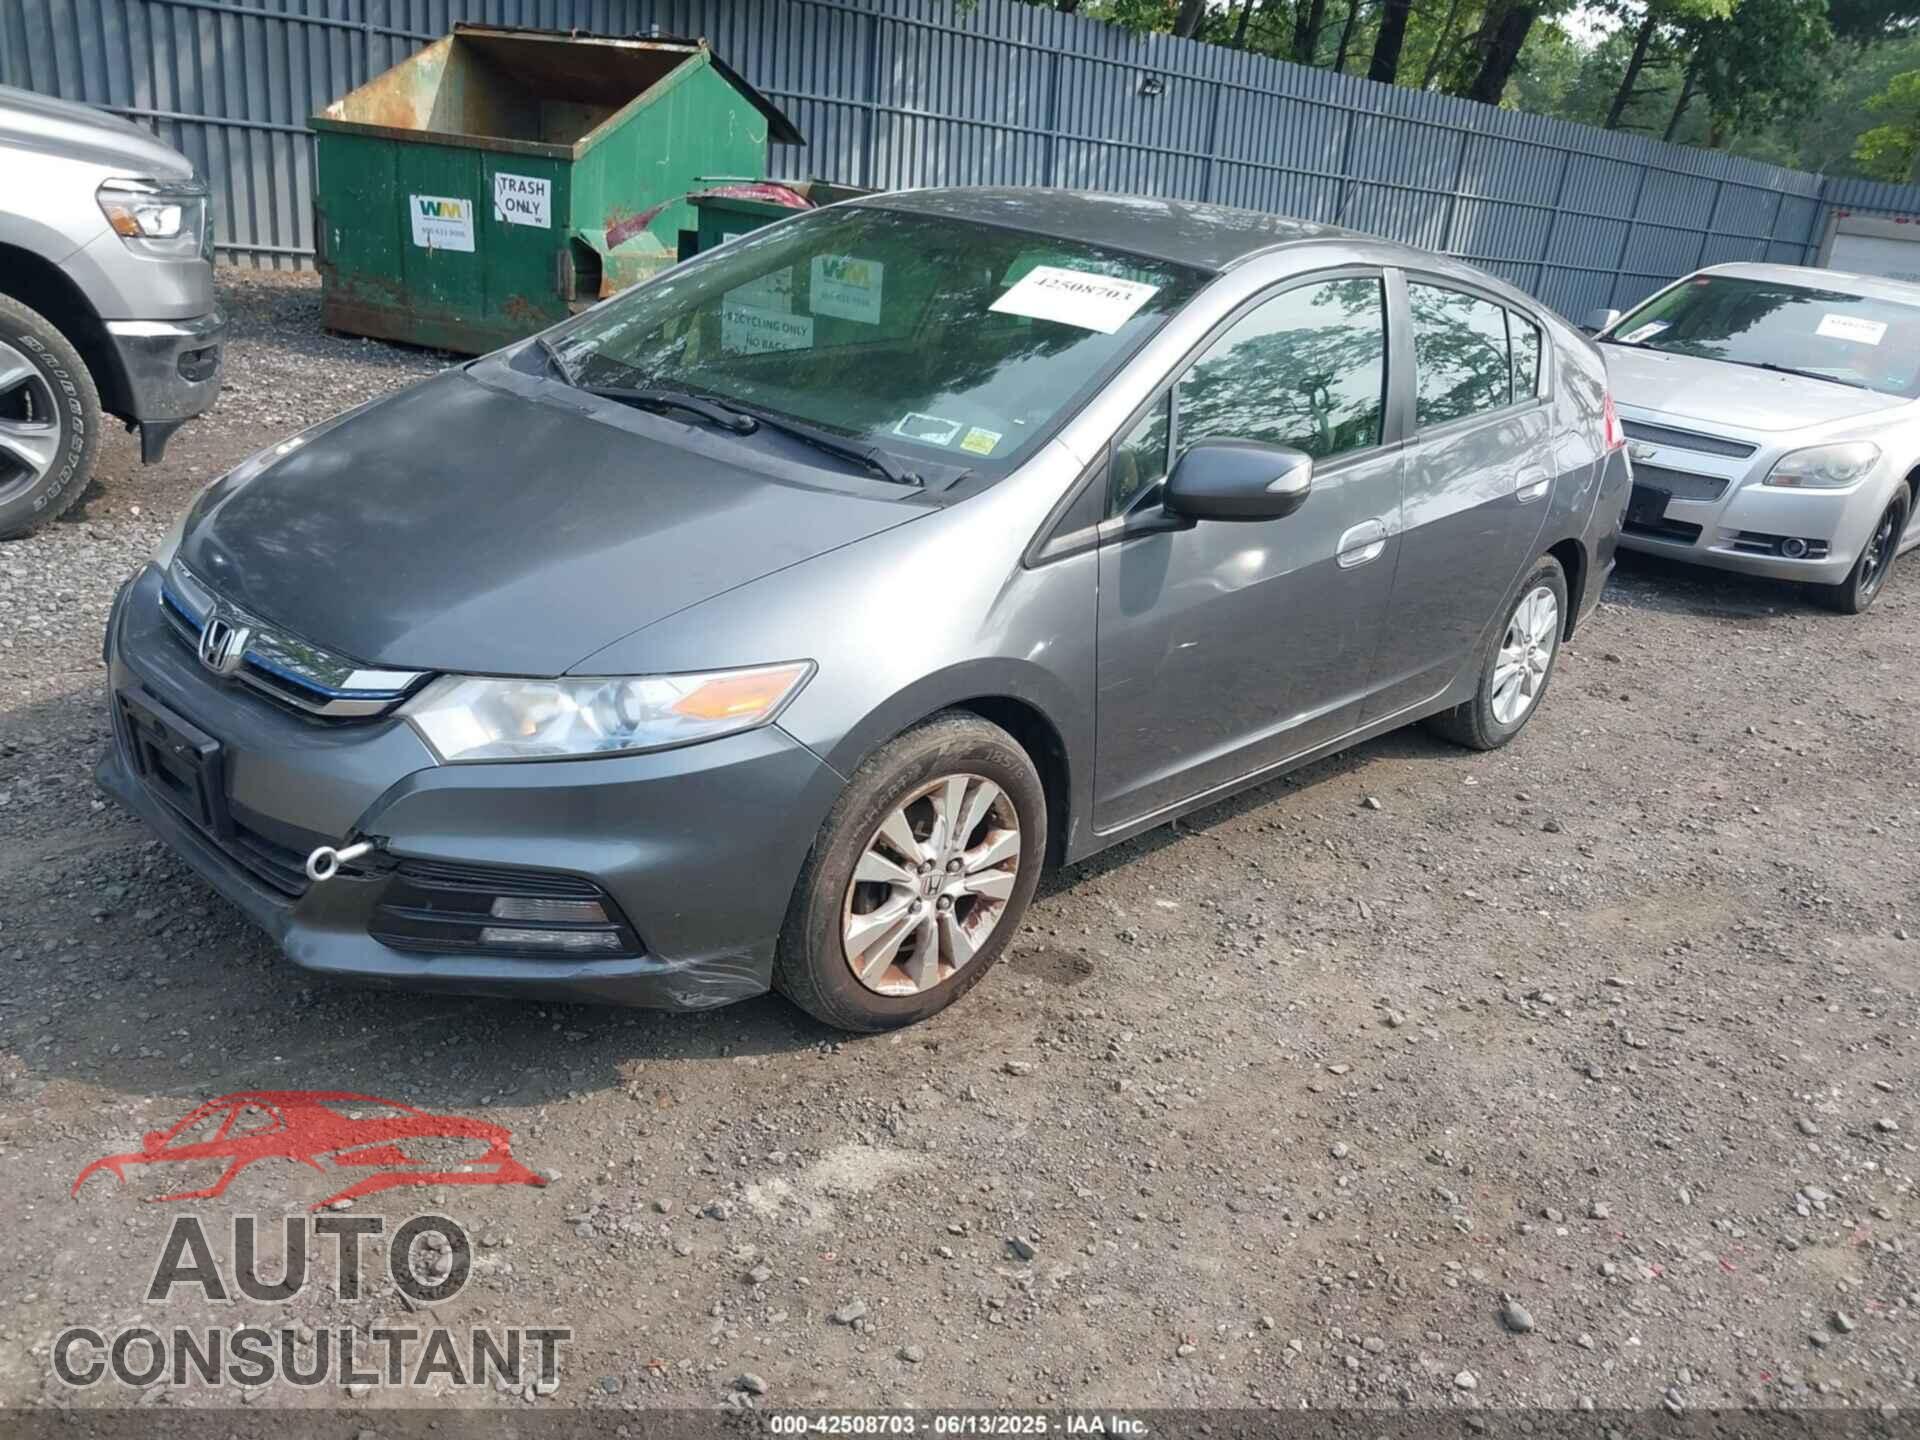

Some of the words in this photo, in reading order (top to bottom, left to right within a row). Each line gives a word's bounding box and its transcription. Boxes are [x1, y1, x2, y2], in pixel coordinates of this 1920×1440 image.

[500, 177, 545, 196] TRASH
[420, 200, 462, 218] WM
[505, 198, 540, 215] ONLY
[1034, 278, 1132, 301] 42508703
[782, 323, 808, 337] ONLY
